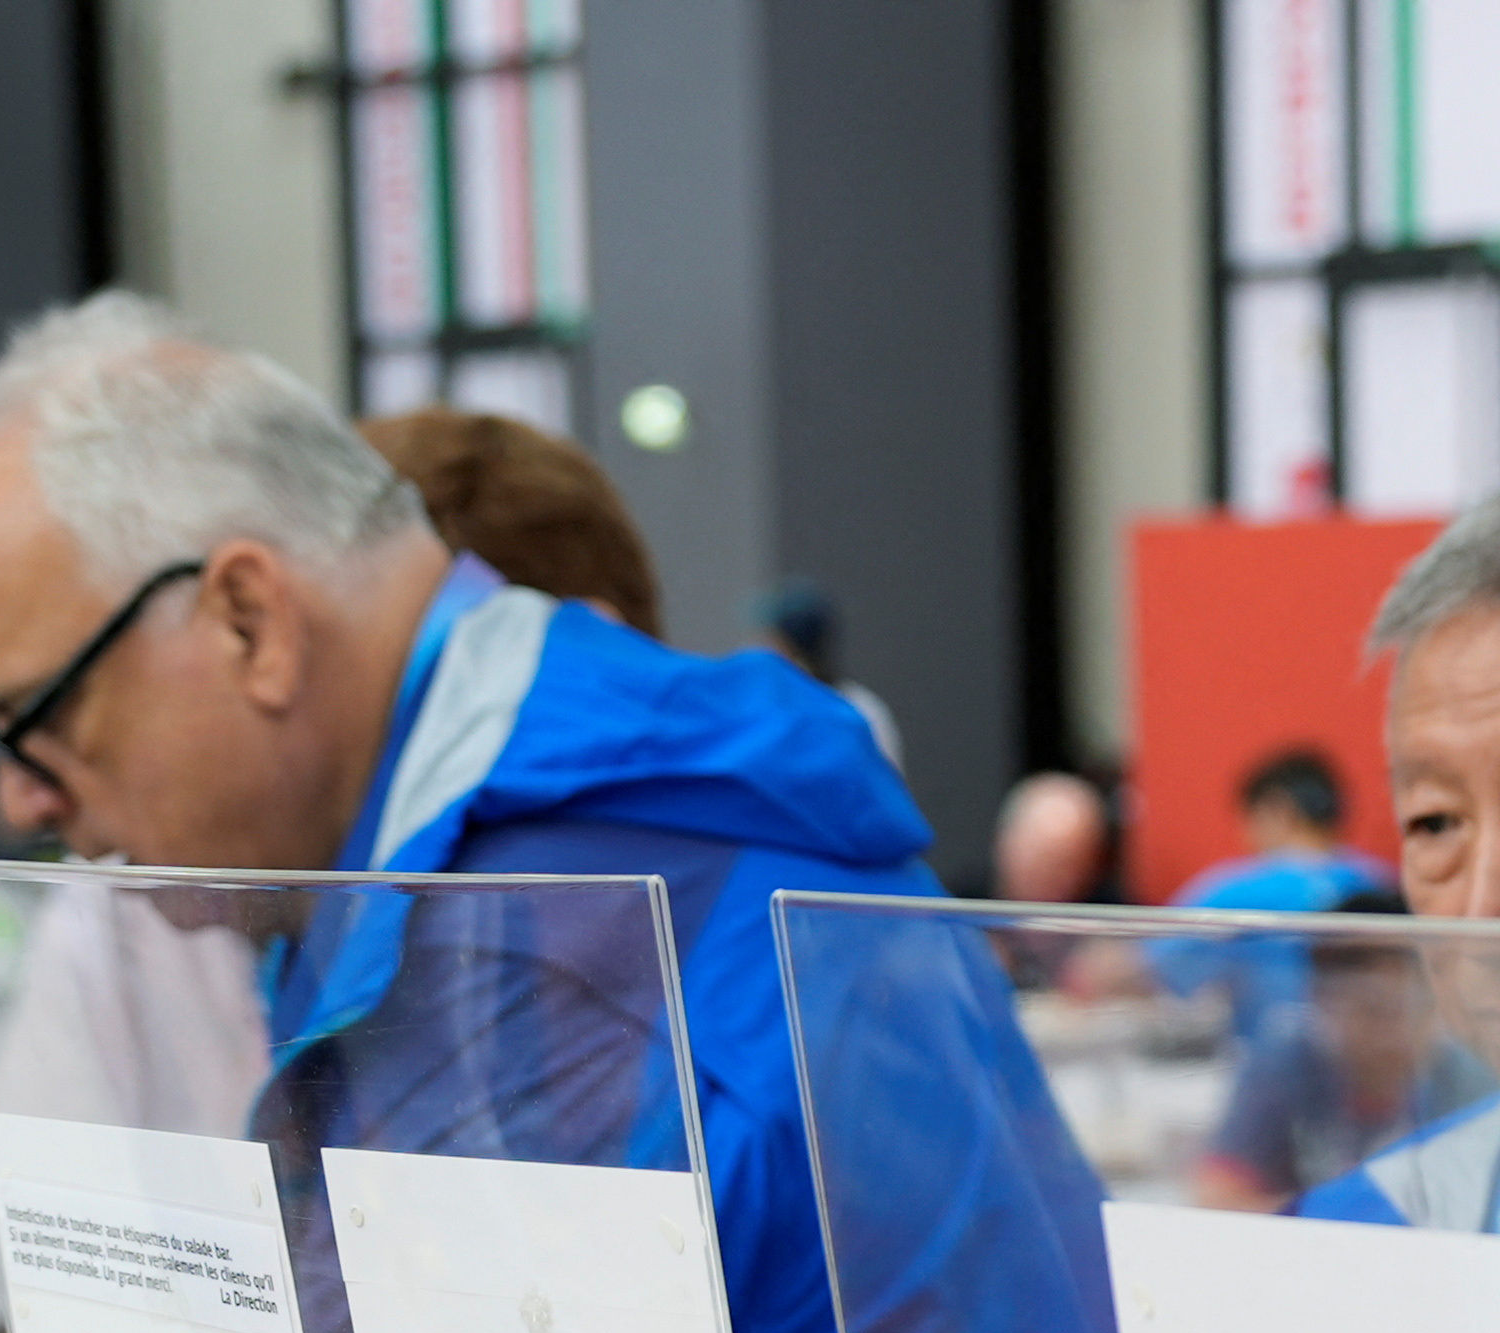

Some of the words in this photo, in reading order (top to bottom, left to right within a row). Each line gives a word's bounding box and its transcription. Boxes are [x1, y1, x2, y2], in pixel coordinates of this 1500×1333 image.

[5, 1206, 56, 1227] Interdiction
[57, 1214, 68, 1230] de
[69, 1217, 103, 1235] toucher
[105, 1225, 122, 1240] aux
[123, 1225, 169, 1249] étiquettes
[171, 1234, 182, 1251] du
[184, 1238, 213, 1258] salade
[214, 1242, 233, 1261] bar.
[8, 1226, 18, 1242] Si
[20, 1231, 30, 1243] un
[33, 1231, 66, 1250] aliment
[68, 1239, 106, 1260] manque,
[106, 1243, 146, 1266] informez
[148, 1253, 204, 1277] verbalement
[204, 1262, 219, 1280] les
[220, 1267, 251, 1287] clients
[36, 1252, 53, 1270] plus
[56, 1255, 101, 1278] disponible.
[103, 1264, 116, 1281] Un
[118, 1271, 143, 1288] grand
[145, 1276, 173, 1292] merci.
[220, 1287, 231, 1305] La
[233, 1290, 278, 1314] Direction
